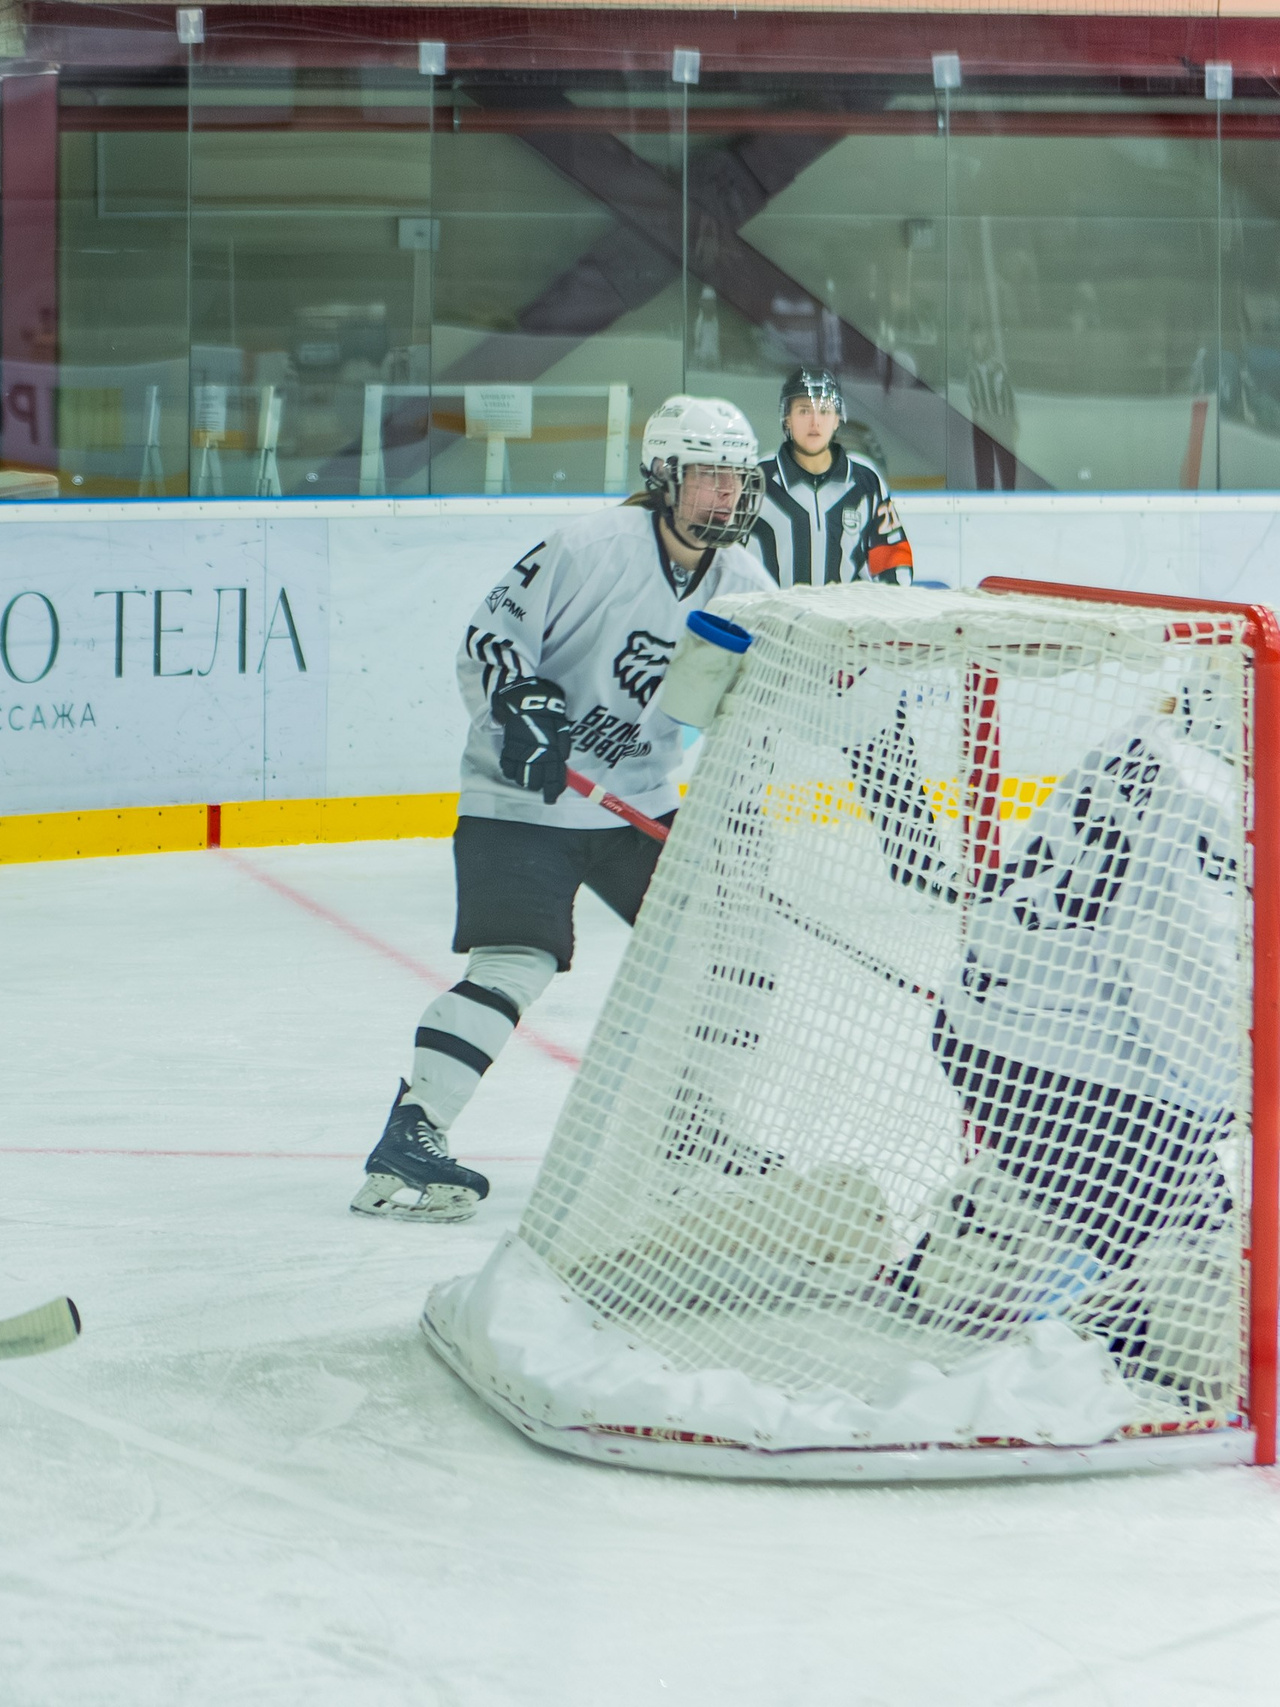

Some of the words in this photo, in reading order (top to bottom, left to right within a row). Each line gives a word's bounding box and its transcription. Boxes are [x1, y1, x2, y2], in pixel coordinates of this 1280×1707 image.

[722, 440, 749, 448] CCM
[513, 541, 546, 589] 4
[94, 586, 308, 679] ТЕЛА
